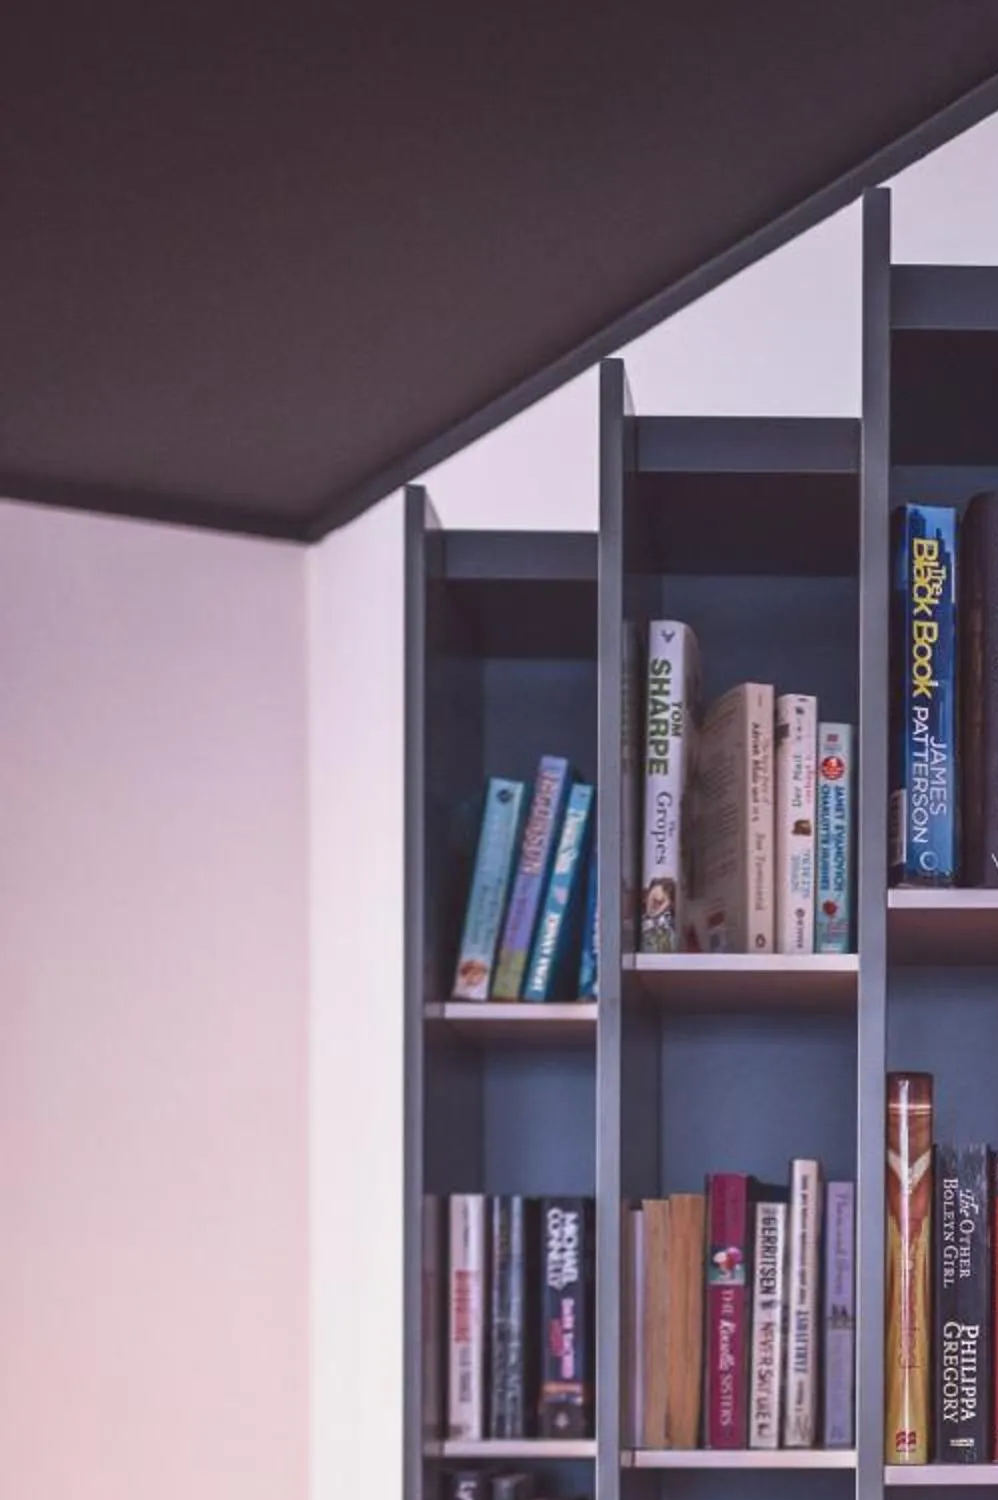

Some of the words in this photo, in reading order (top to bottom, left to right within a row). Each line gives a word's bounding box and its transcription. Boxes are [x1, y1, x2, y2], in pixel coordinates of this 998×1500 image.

[912, 538, 939, 615] Black
[930, 567, 946, 595] The
[912, 620, 937, 700] Book
[649, 659, 670, 776] SHARPE
[670, 701, 682, 737] TOM
[833, 785, 845, 817] JANET
[911, 705, 929, 844] PATTERSON
[929, 736, 947, 816] JAMES
[653, 791, 672, 865] Gropes
[821, 784, 831, 845] CHARLOTTE
[821, 847, 831, 891] HUGHES
[833, 825, 846, 892] EVANOVICH
[943, 1178, 958, 1242] BOLEYN
[959, 1189, 979, 1218] The
[546, 1207, 564, 1290] CONNELLY
[563, 1211, 578, 1284] MICHAEL
[761, 1217, 778, 1294] GERRITSEN
[943, 1245, 958, 1289] GIRL
[959, 1219, 974, 1278] OTHER
[721, 1290, 734, 1315] THE
[760, 1321, 776, 1366] NEVER
[942, 1321, 960, 1424] GREGORY
[960, 1325, 978, 1422] PHILIPPA
[720, 1374, 733, 1426] SISTERS
[756, 1370, 771, 1394] SAY
